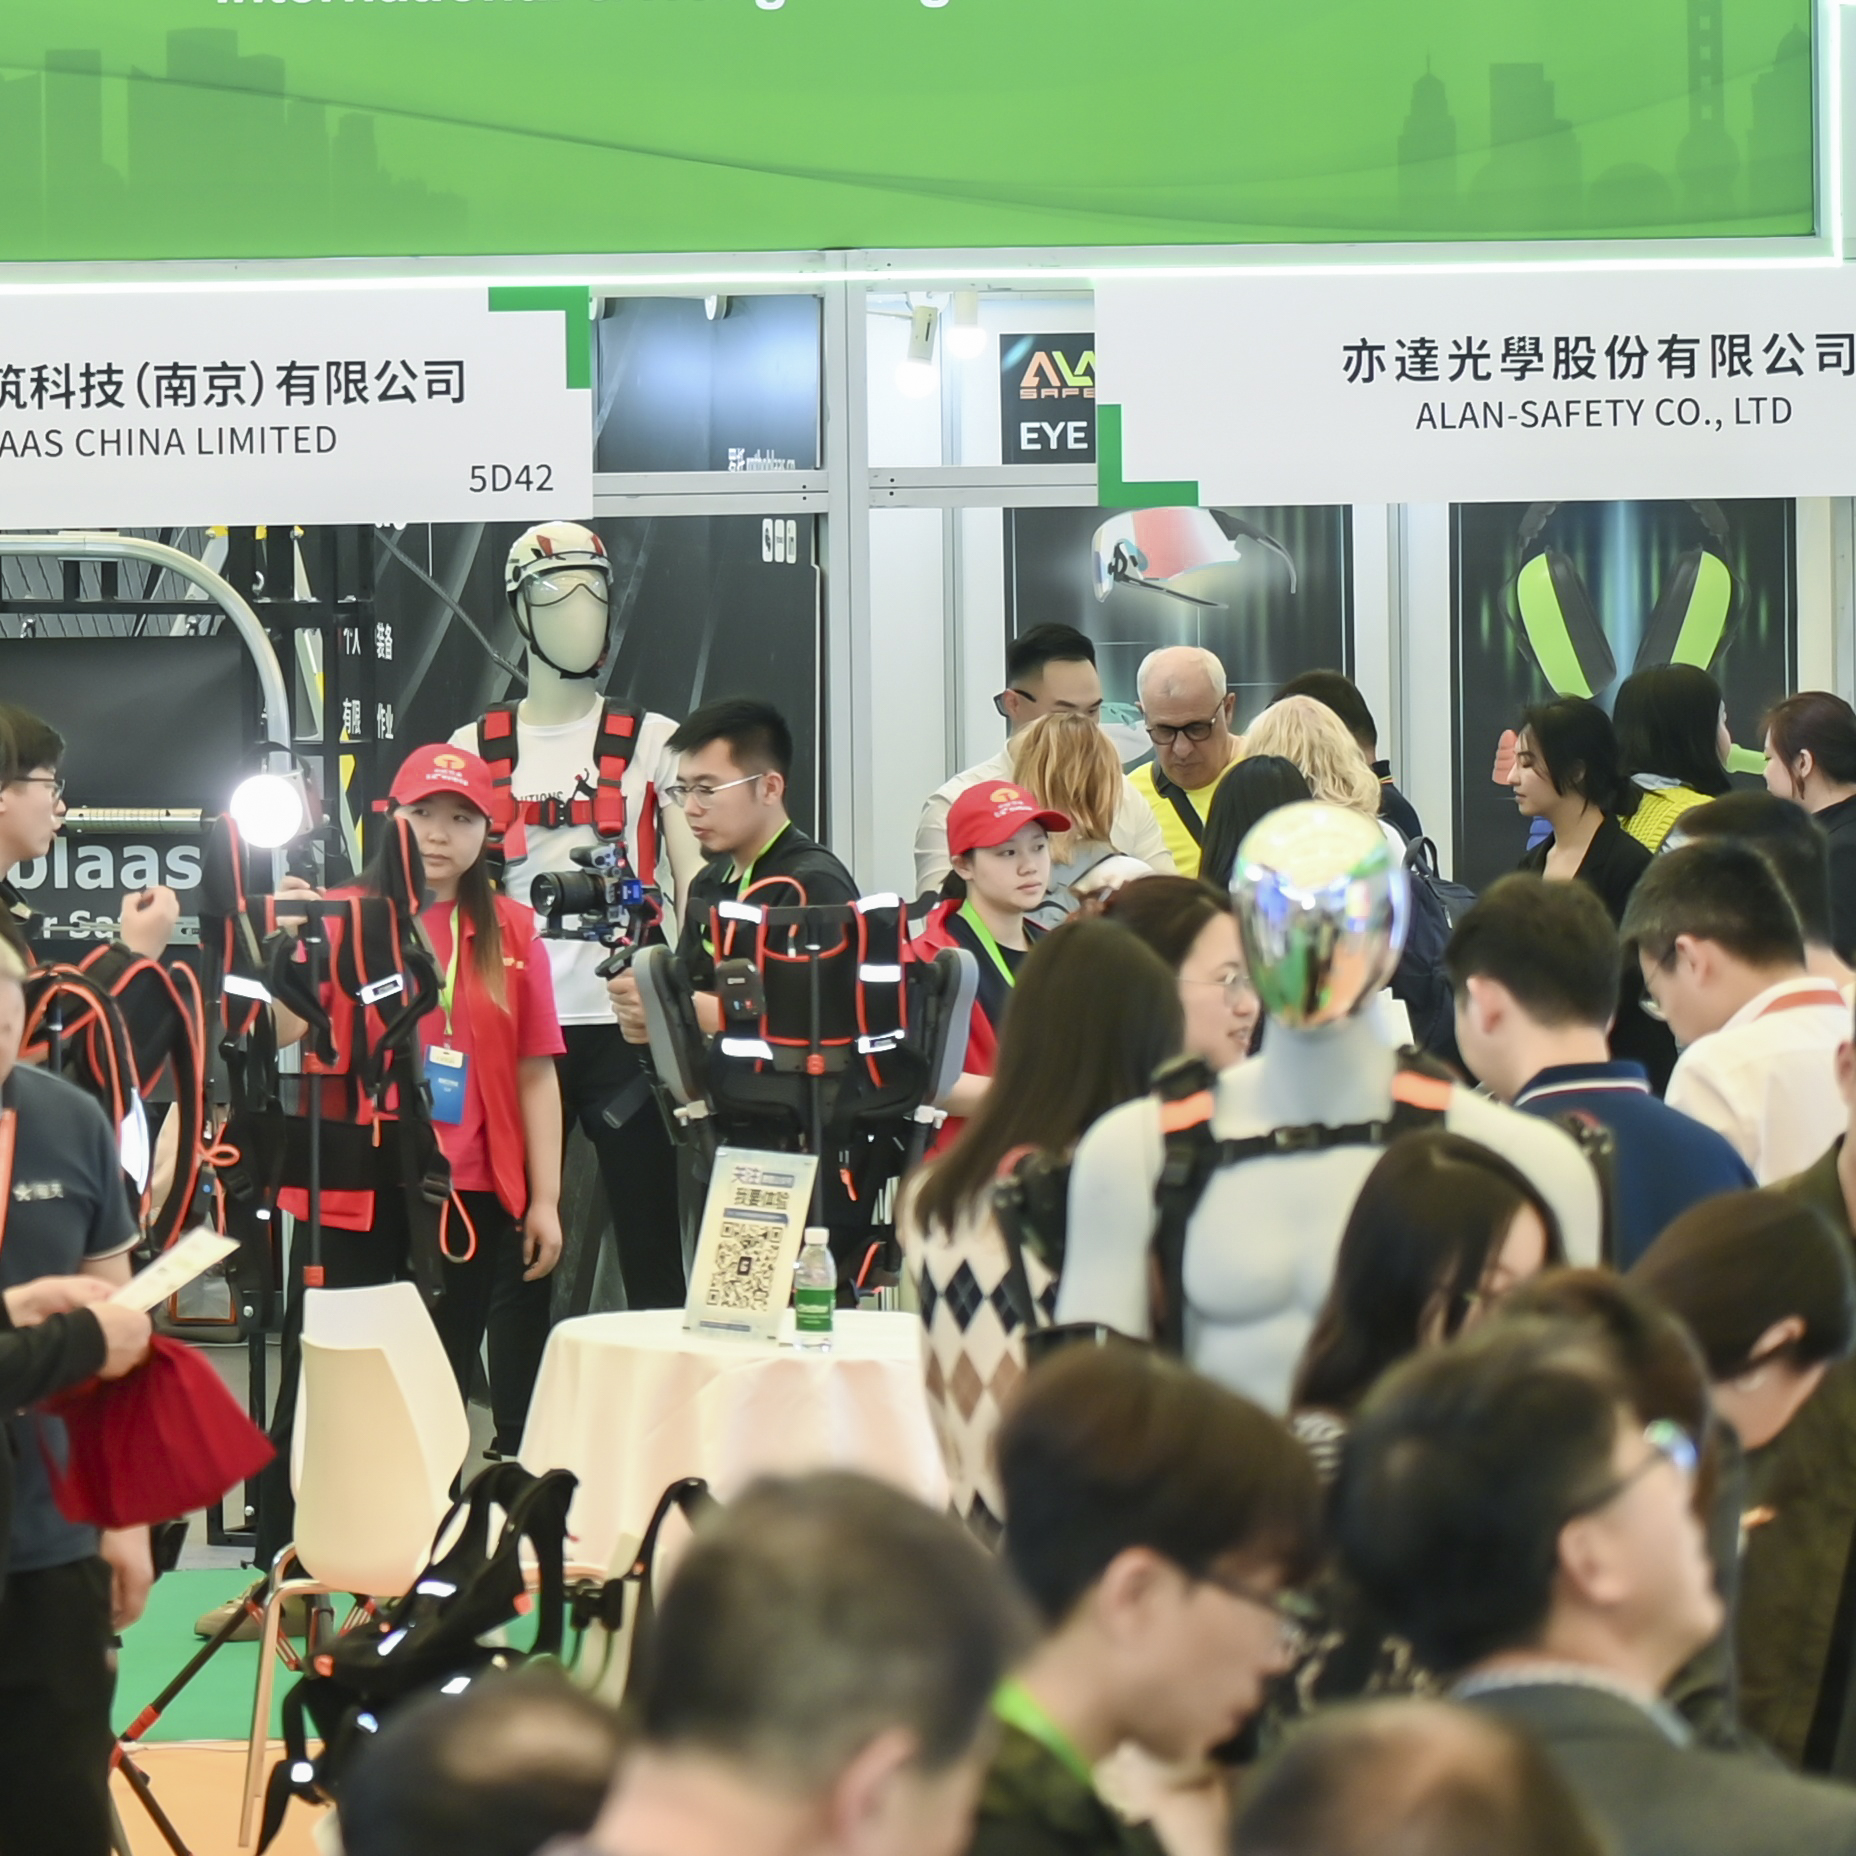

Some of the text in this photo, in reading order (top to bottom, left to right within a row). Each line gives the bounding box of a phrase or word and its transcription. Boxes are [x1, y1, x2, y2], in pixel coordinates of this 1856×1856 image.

[1342, 332, 1856, 385] 亦達光學股份有限公司
[1415, 396, 1794, 432] ALAN-SAFETY CO., LTD
[75, 427, 186, 457] CHINA
[197, 425, 337, 455] LIMITED
[1020, 420, 1089, 450] EYE
[468, 463, 555, 493] 5D42
